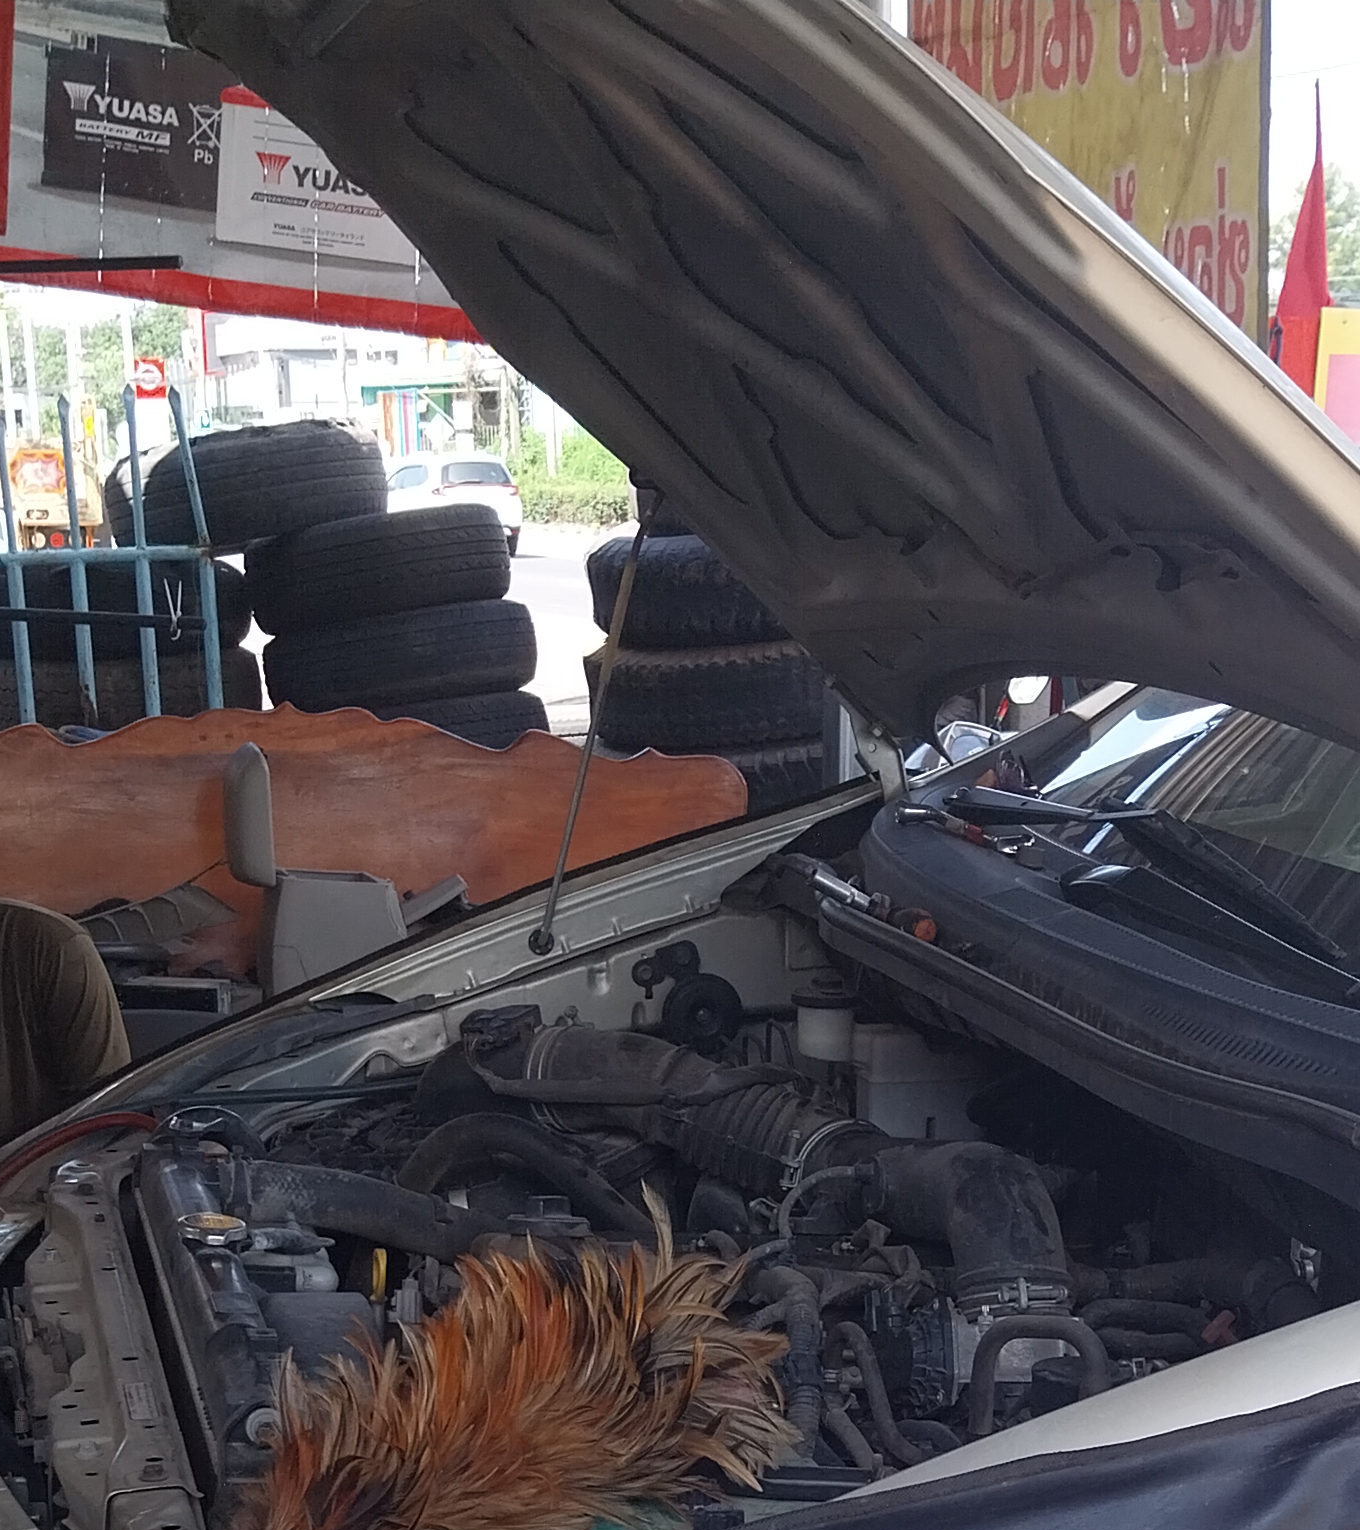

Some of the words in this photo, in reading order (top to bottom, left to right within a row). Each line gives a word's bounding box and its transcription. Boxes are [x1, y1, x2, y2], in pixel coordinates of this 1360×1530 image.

[94, 94, 179, 127] YUASA
[194, 149, 214, 165] Pb
[292, 165, 368, 197] YUA
